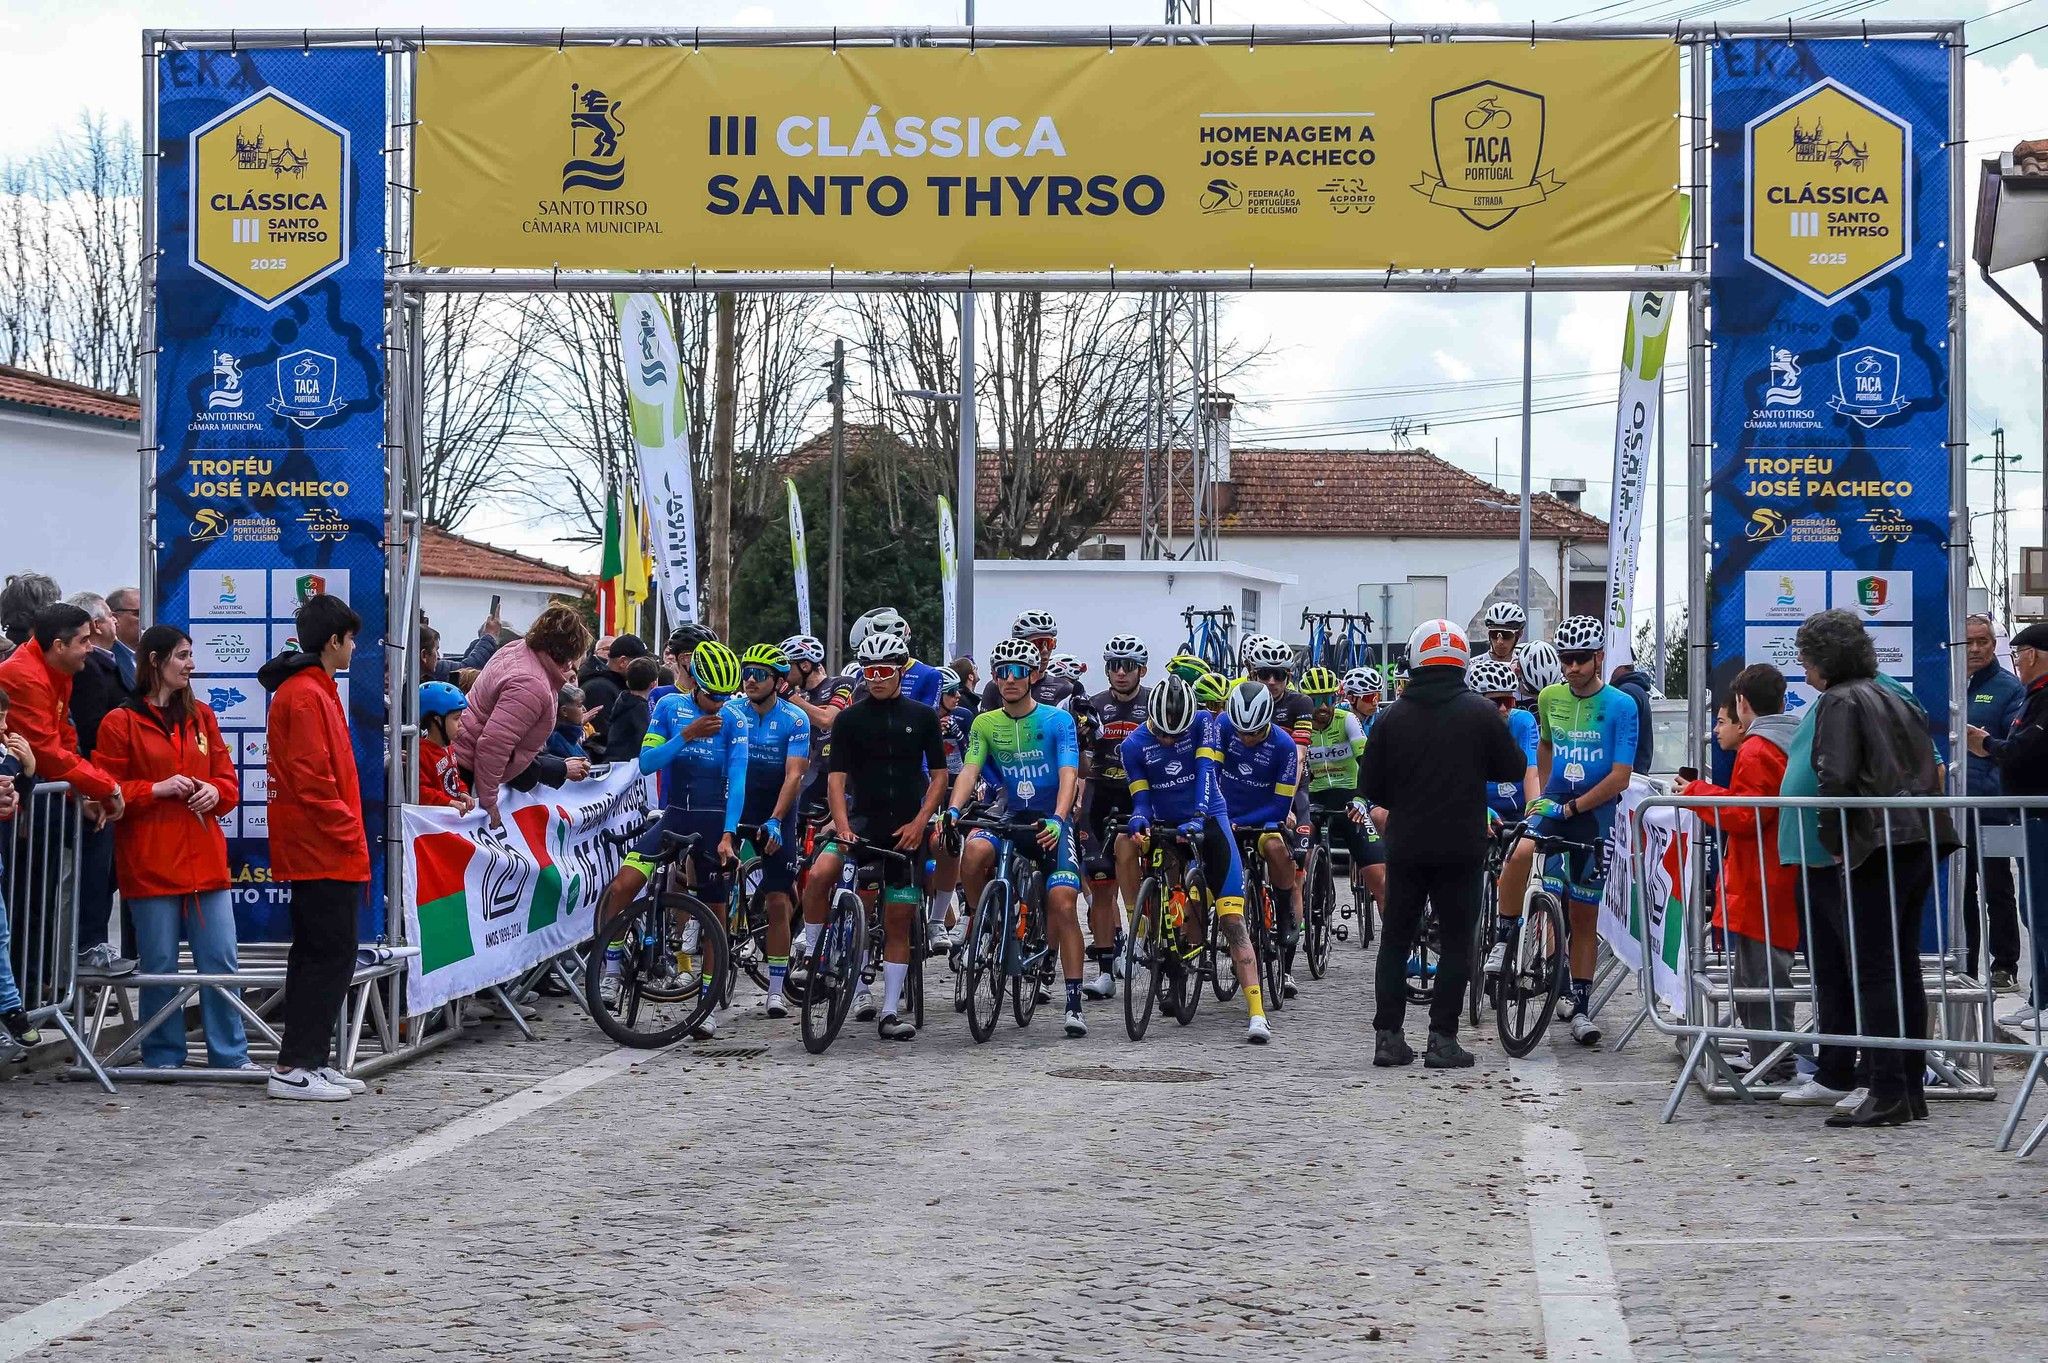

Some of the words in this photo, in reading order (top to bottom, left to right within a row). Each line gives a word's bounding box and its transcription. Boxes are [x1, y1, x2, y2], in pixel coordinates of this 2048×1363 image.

[709, 116, 757, 156] III
[776, 104, 1067, 157] CLÁSSICA
[1200, 125, 1351, 143] HOMENAGEM
[1359, 126, 1375, 142] A
[1200, 146, 1258, 167] JOSÉ
[1265, 149, 1376, 166] PACHECO
[1465, 136, 1512, 167] TAÇA
[1465, 166, 1514, 181] PORTUGAL
[706, 174, 909, 216] SANTO
[926, 174, 1166, 216] THYRSO
[1248, 188, 1295, 198] FEDERAÇÃO
[1329, 195, 1376, 203] ACPORTO
[1767, 182, 1889, 204] CLÁSSICA
[210, 189, 328, 211] CLÁSSICA
[1248, 198, 1301, 206] PORTUGUESA
[1473, 196, 1503, 206] ESTRADA
[538, 200, 595, 216] SANTO
[599, 200, 648, 216] TIRSO
[1248, 206, 1259, 214] DE
[1260, 206, 1298, 214] CICLISMO
[268, 218, 319, 229] SANTO
[1827, 212, 1880, 223] SANTO
[232, 218, 260, 243] III
[522, 217, 581, 234] CÂMARA
[586, 221, 663, 234] MUNICIPAL
[1790, 212, 1819, 237] III
[268, 231, 328, 243] THYRSO
[1827, 226, 1889, 237] THYRSO
[250, 258, 287, 270] 2025
[1808, 253, 1847, 265] 2025
[294, 380, 320, 395] TAÇA
[1855, 377, 1882, 392] TAÇA
[196, 412, 227, 421] SANTO
[227, 412, 255, 421] TIRSO
[1753, 410, 1785, 419] SANTO
[1786, 410, 1815, 419] TIRSO
[188, 422, 220, 431] CÂMARA
[222, 423, 264, 431] MUNICIPAL
[1744, 420, 1778, 429] CÂMARA
[1780, 421, 1824, 429] MUNICIPAL
[189, 456, 273, 475] TROFÉU
[1745, 455, 1833, 474] TROFÉU
[188, 478, 241, 497] JOSÉ
[248, 481, 349, 497] PACHECO
[1744, 477, 1800, 497] JOSÉ
[1807, 480, 1913, 497] PACHECO
[233, 517, 276, 527] FEDERAÇÃO
[307, 523, 350, 531] ACPORTO
[1791, 518, 1836, 528] FEDERAÇÃO
[1868, 524, 1913, 532] ACPORTO
[233, 527, 282, 535] PORTUGUESA
[1791, 527, 1842, 535] PORTUGUESA
[233, 534, 243, 542] DE
[244, 534, 279, 542] CICLISMO
[1176, 773, 1196, 784] GRO
